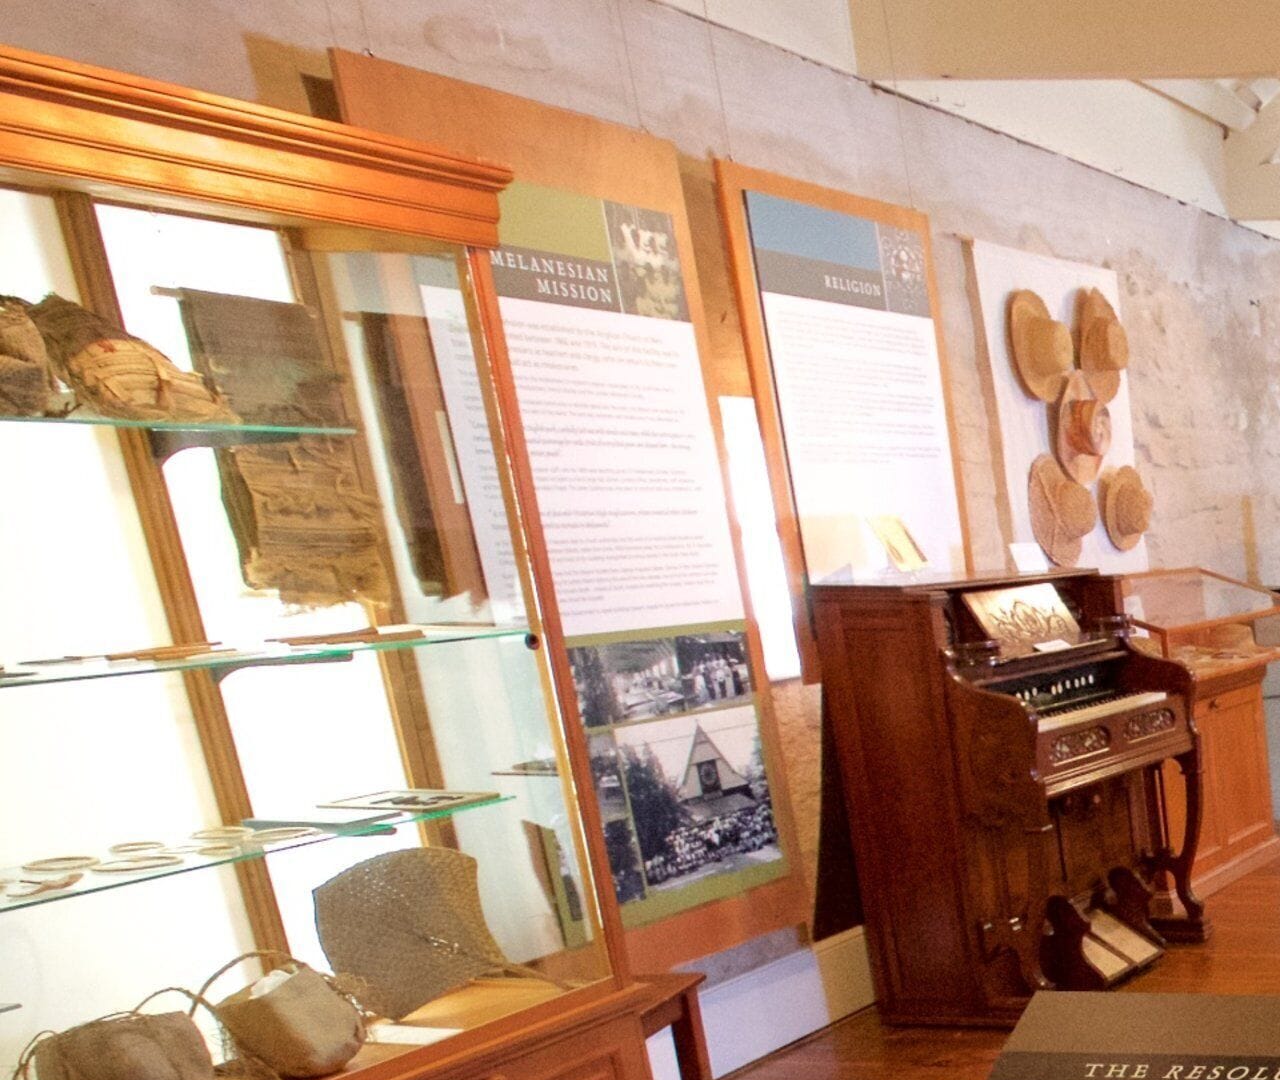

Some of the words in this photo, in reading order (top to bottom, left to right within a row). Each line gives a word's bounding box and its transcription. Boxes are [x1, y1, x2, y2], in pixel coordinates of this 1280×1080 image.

[489, 250, 608, 283] MELANESIAN
[536, 279, 612, 303] MISSION
[824, 275, 881, 296] RELIGION
[1084, 1063, 1149, 1078] THE
